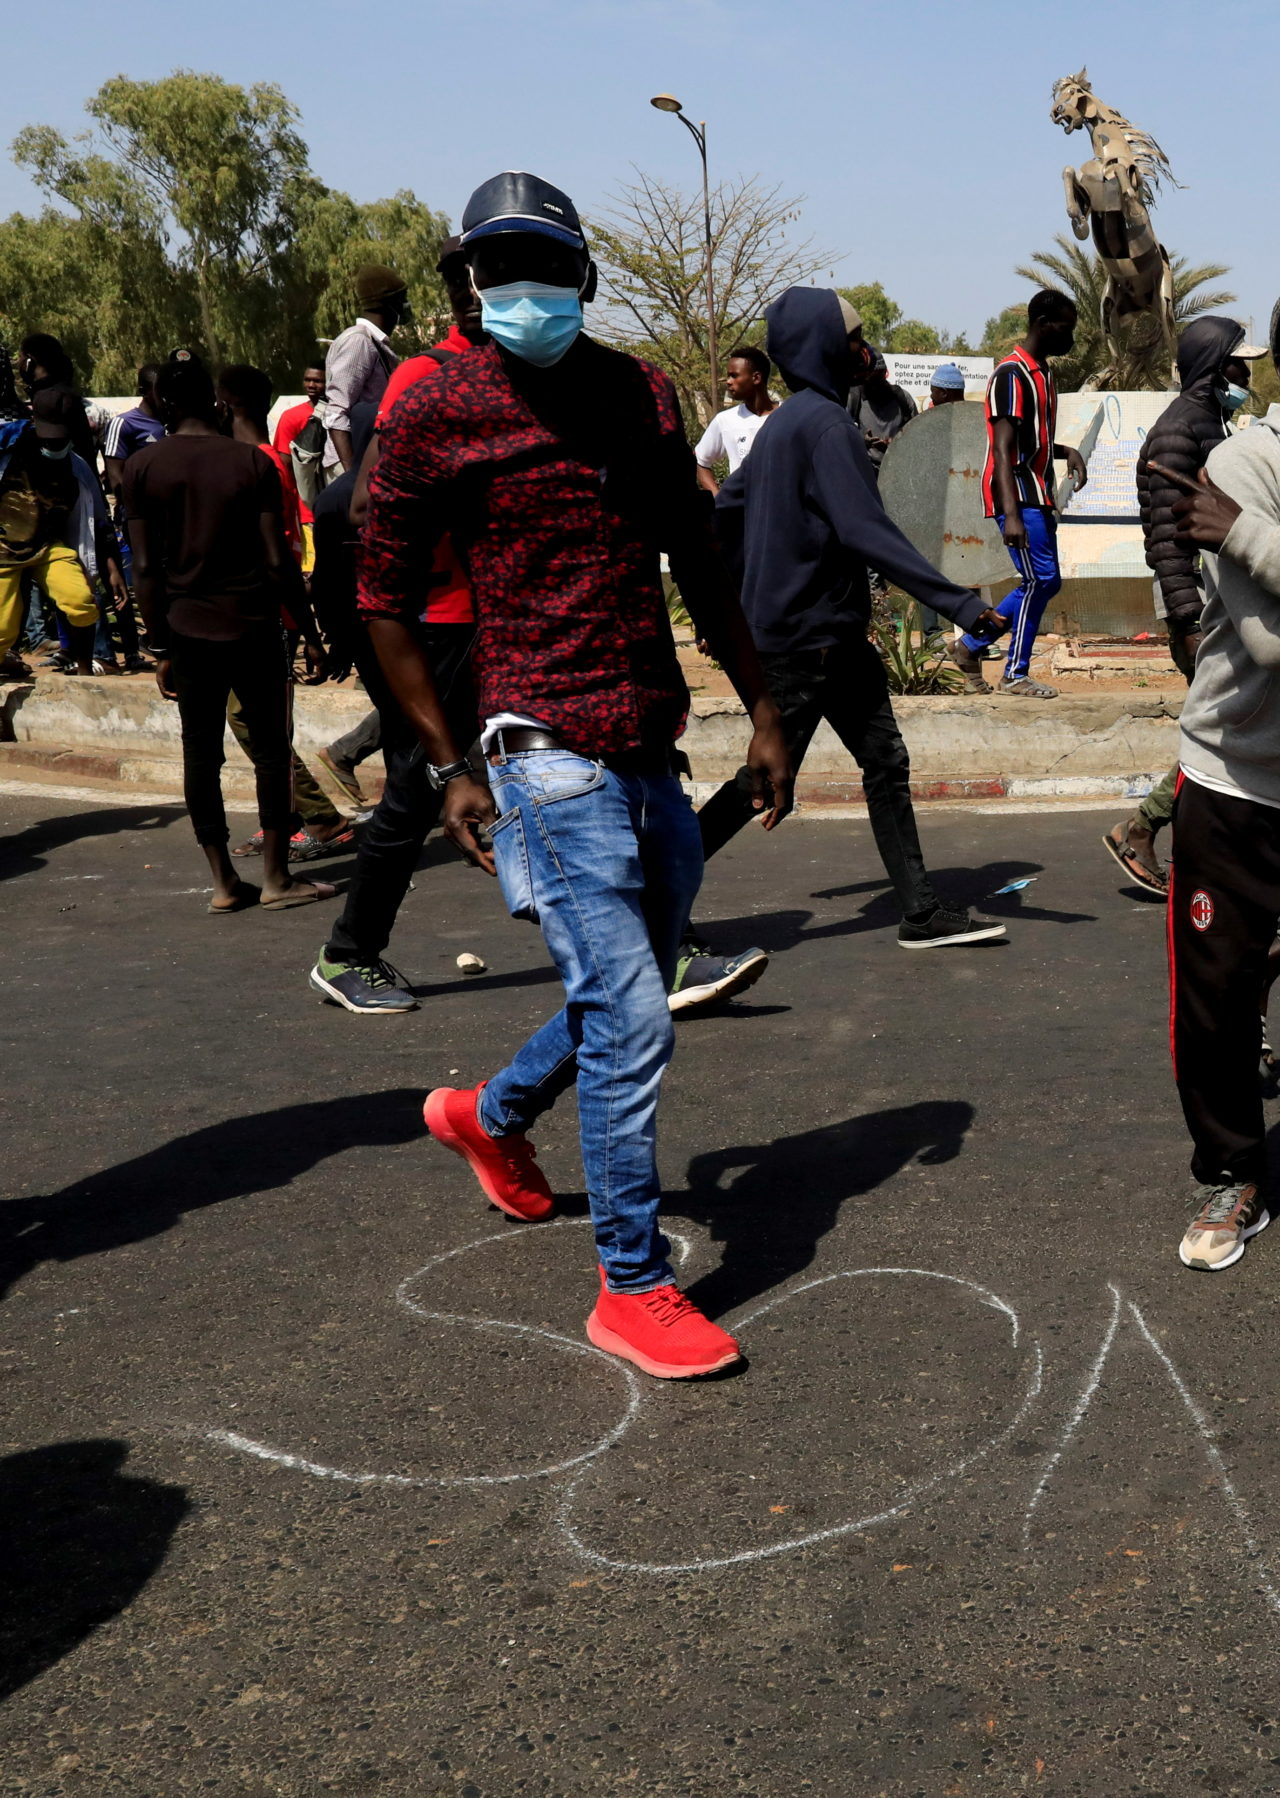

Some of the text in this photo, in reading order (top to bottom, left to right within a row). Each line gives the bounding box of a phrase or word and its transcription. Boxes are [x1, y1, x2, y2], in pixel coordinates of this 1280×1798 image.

[894, 362, 911, 370] Pour
[894, 370, 914, 379] optez
[916, 371, 931, 380] pour
[895, 378, 913, 386] riche
[914, 378, 921, 386] et
